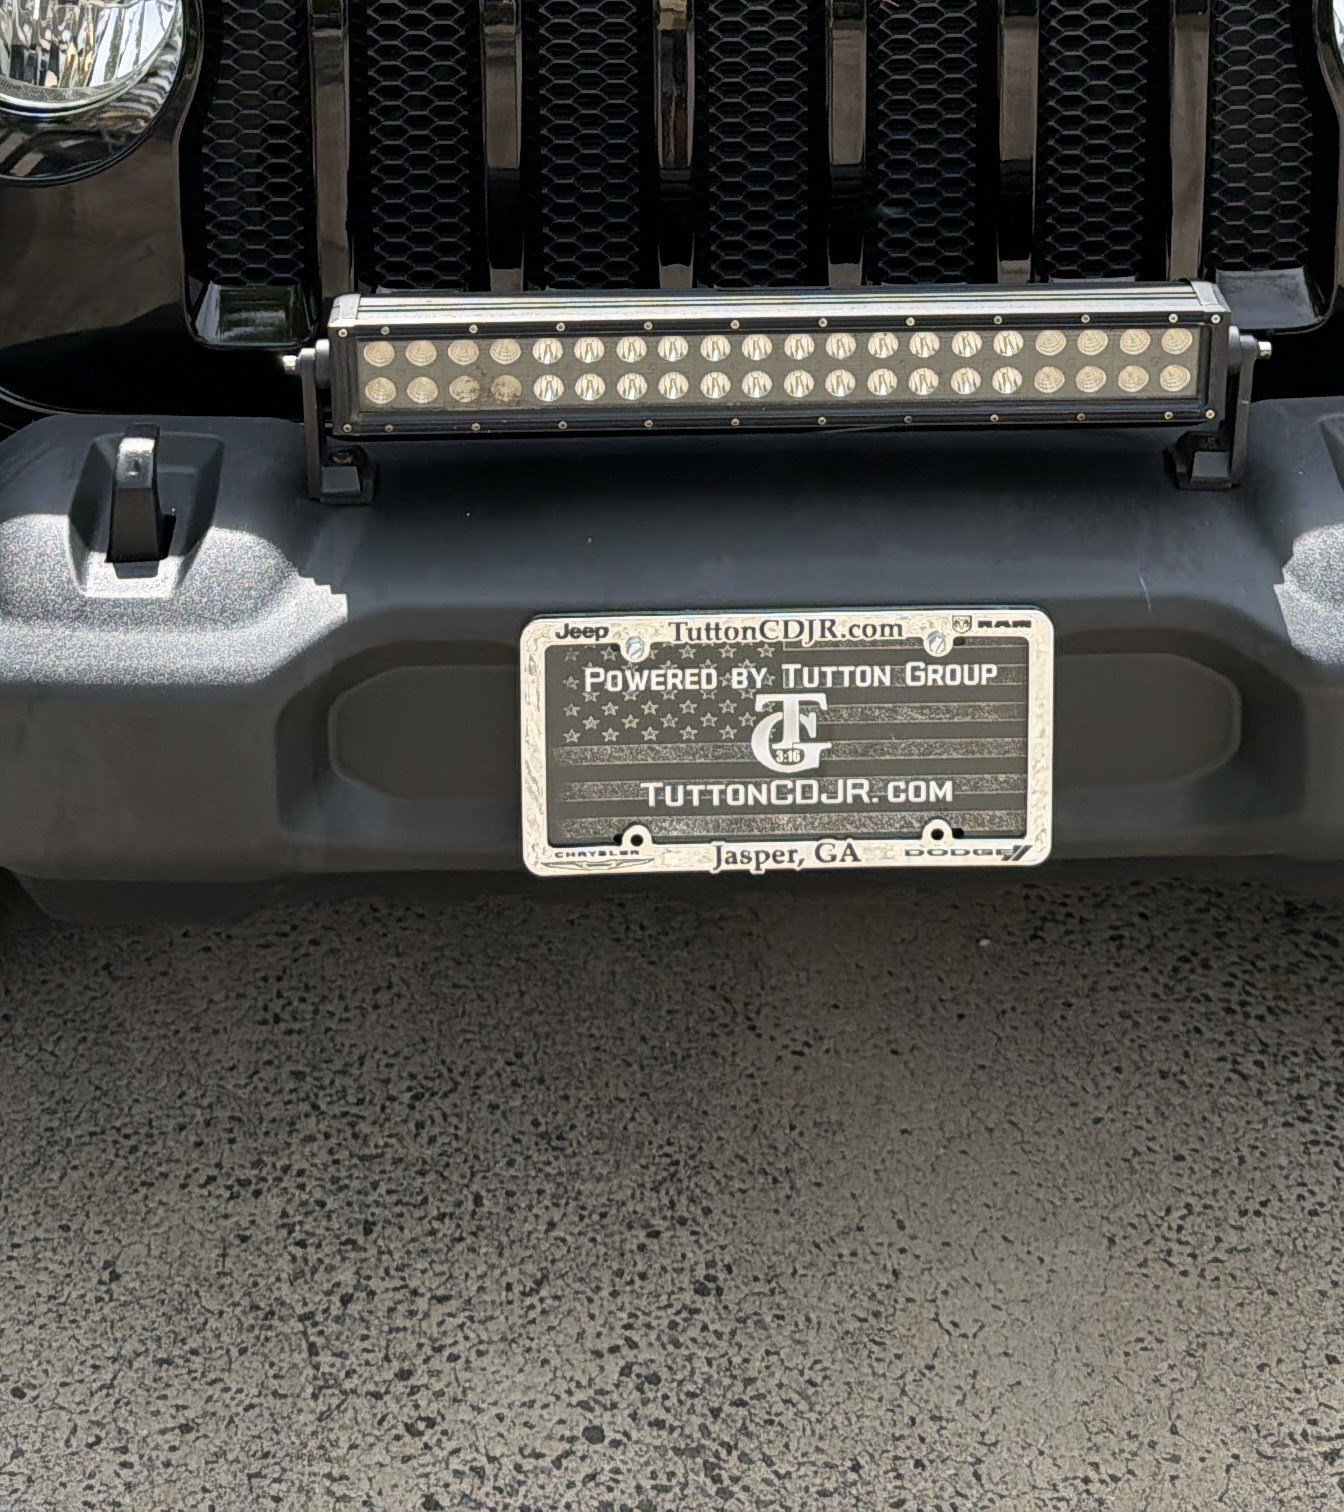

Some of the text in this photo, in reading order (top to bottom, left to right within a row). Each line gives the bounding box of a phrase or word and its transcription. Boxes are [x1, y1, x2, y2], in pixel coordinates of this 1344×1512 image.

[555, 622, 610, 642] Jeep
[668, 619, 904, 644] TuttonCDJR.com
[977, 619, 1032, 629] RAM
[584, 661, 998, 693] POWERED BY TUTTON GROUP
[554, 849, 640, 859] CHRYSLER
[713, 841, 862, 871] Jasper, GA
[904, 848, 1014, 858] DODGE
